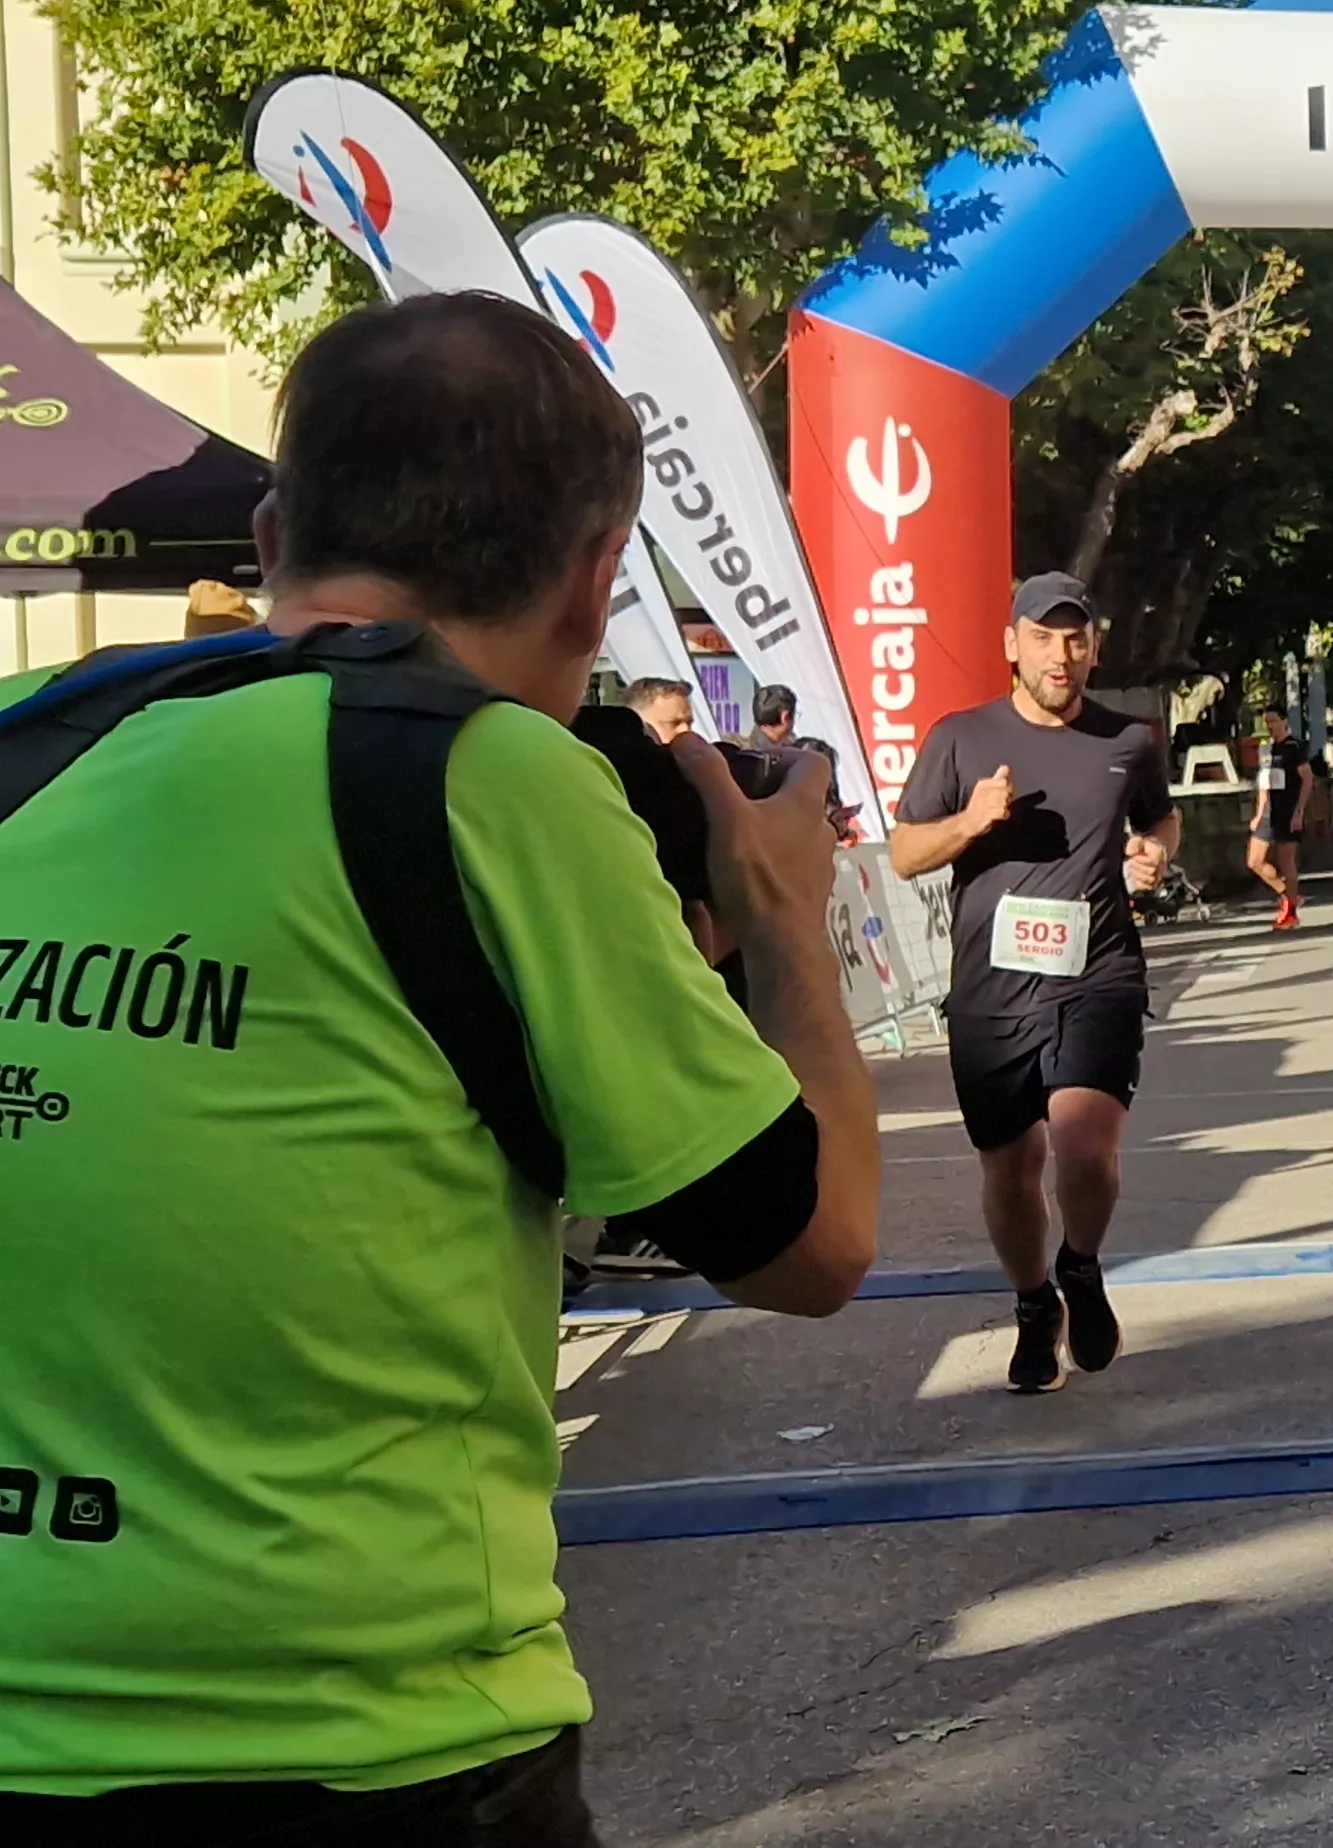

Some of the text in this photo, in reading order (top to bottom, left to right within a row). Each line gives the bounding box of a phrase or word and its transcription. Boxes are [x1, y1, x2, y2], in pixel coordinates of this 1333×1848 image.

[1014, 920, 1068, 945] 503
[1016, 943, 1064, 957] SERGIO
[0, 1064, 39, 1096] CK
